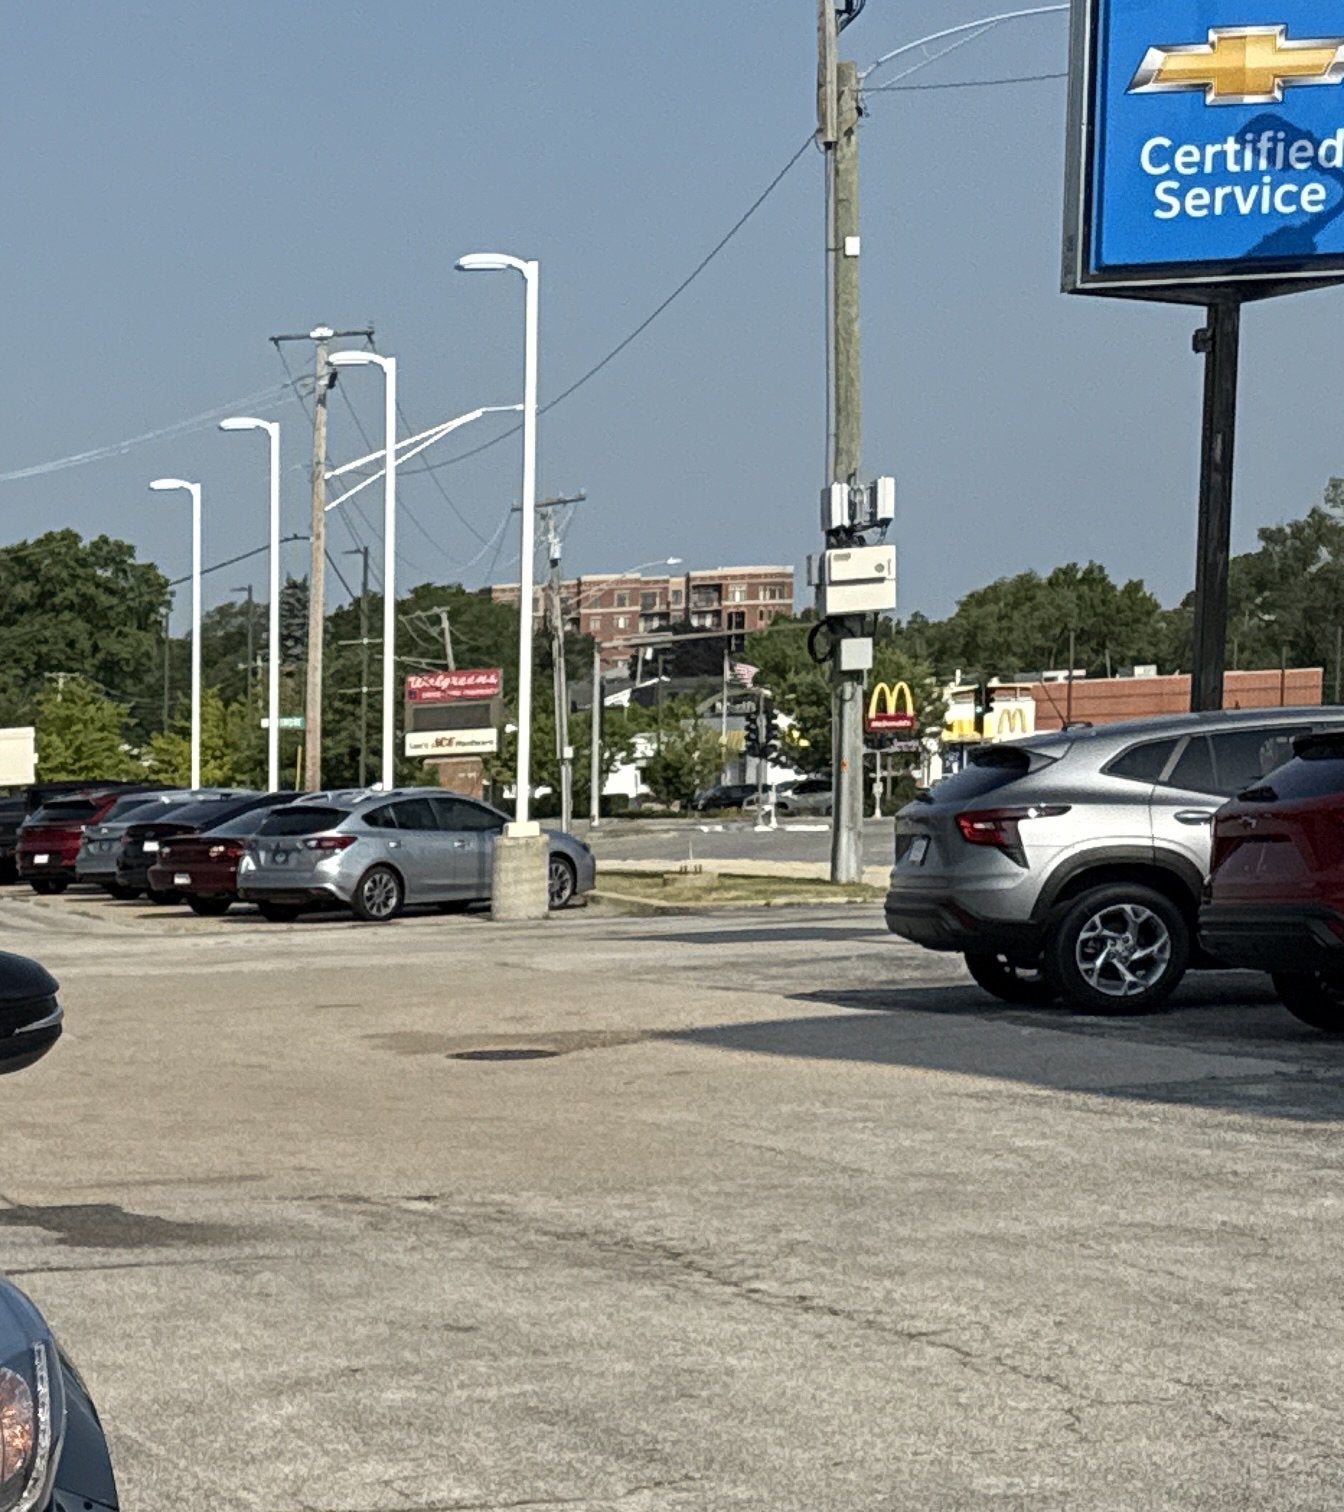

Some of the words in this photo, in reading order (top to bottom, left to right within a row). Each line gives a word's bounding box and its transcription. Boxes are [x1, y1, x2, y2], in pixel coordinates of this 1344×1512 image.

[1140, 129, 1344, 175] Certified
[1153, 176, 1327, 219] Service
[408, 674, 498, 690] Walgreens
